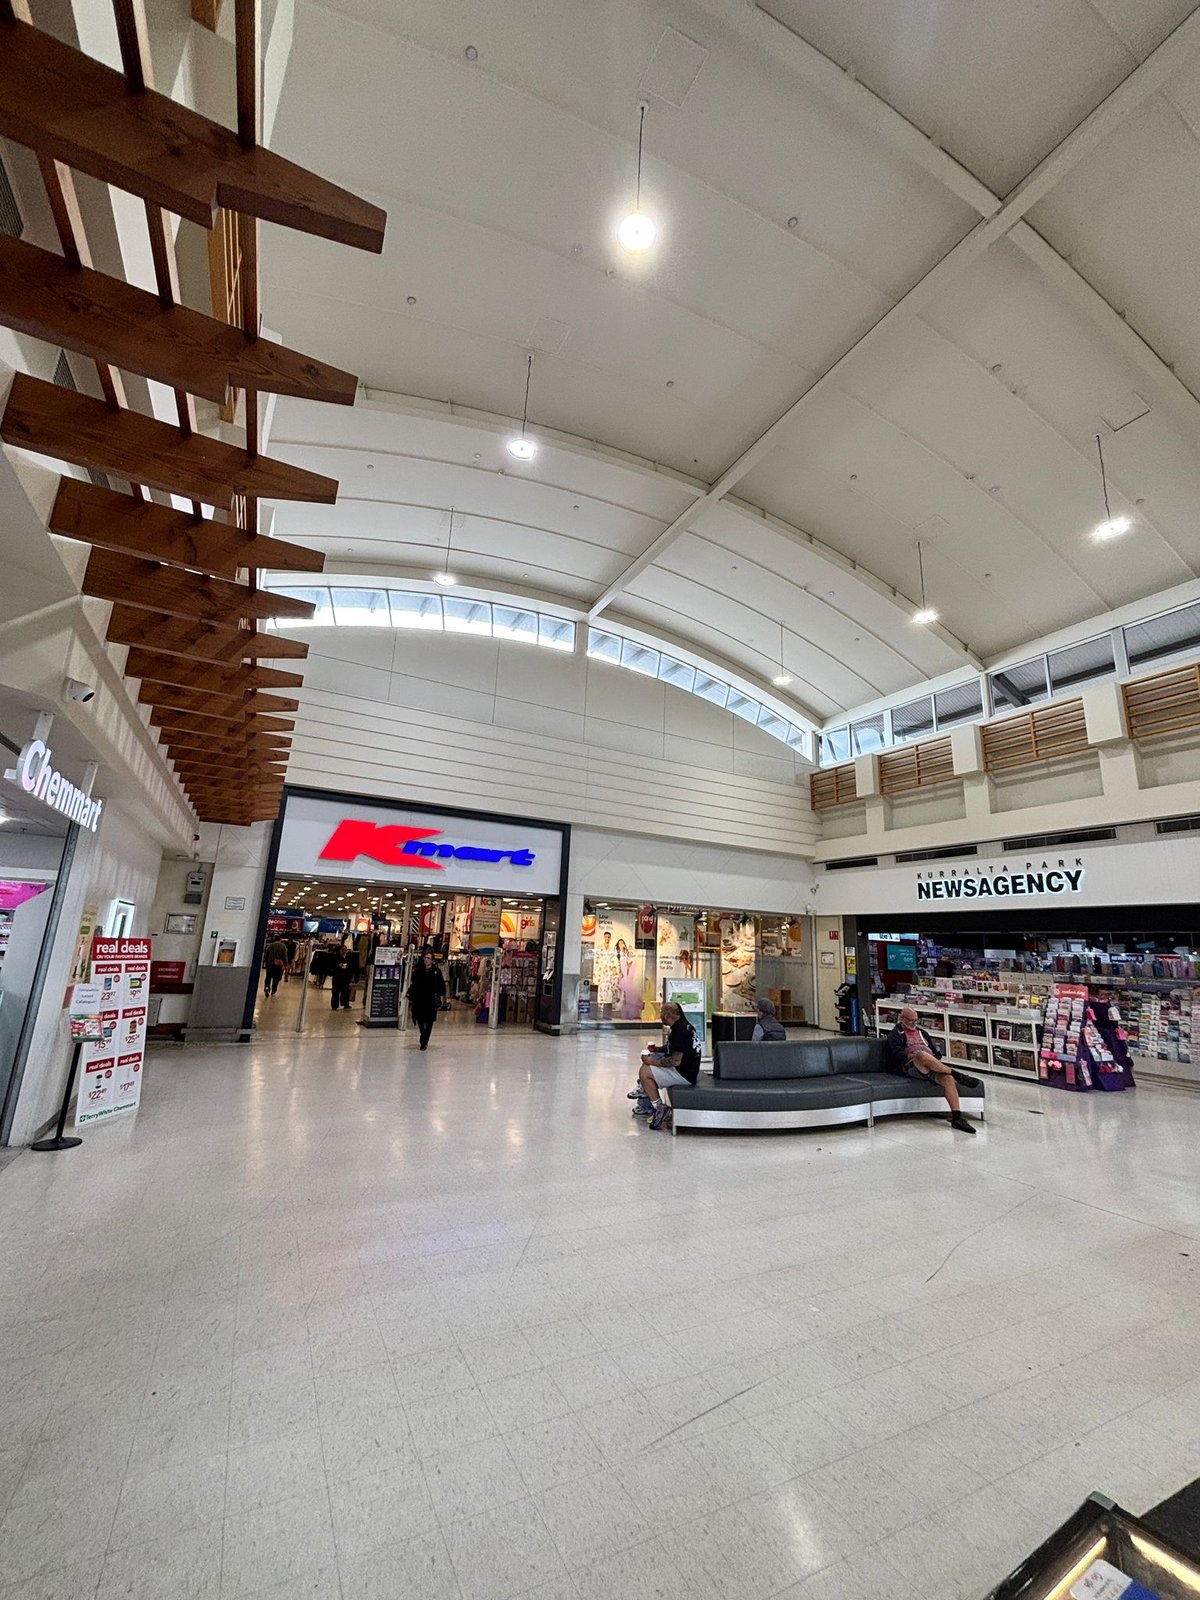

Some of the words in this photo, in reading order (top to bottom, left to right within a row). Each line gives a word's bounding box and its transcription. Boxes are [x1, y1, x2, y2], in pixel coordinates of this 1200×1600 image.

[22, 740, 102, 832] Chemmart
[319, 819, 535, 870] Kmart
[917, 865, 1008, 879] KURRALTA
[1026, 858, 1082, 870] PARK
[917, 870, 1083, 899] NEWSAGENCY
[96, 940, 118, 953] real
[121, 940, 148, 953] deals
[1111, 955, 1143, 963] NEWSPOWR
[86, 1109, 113, 1120] TerryWhite
[113, 1102, 136, 1112] Chemmart
